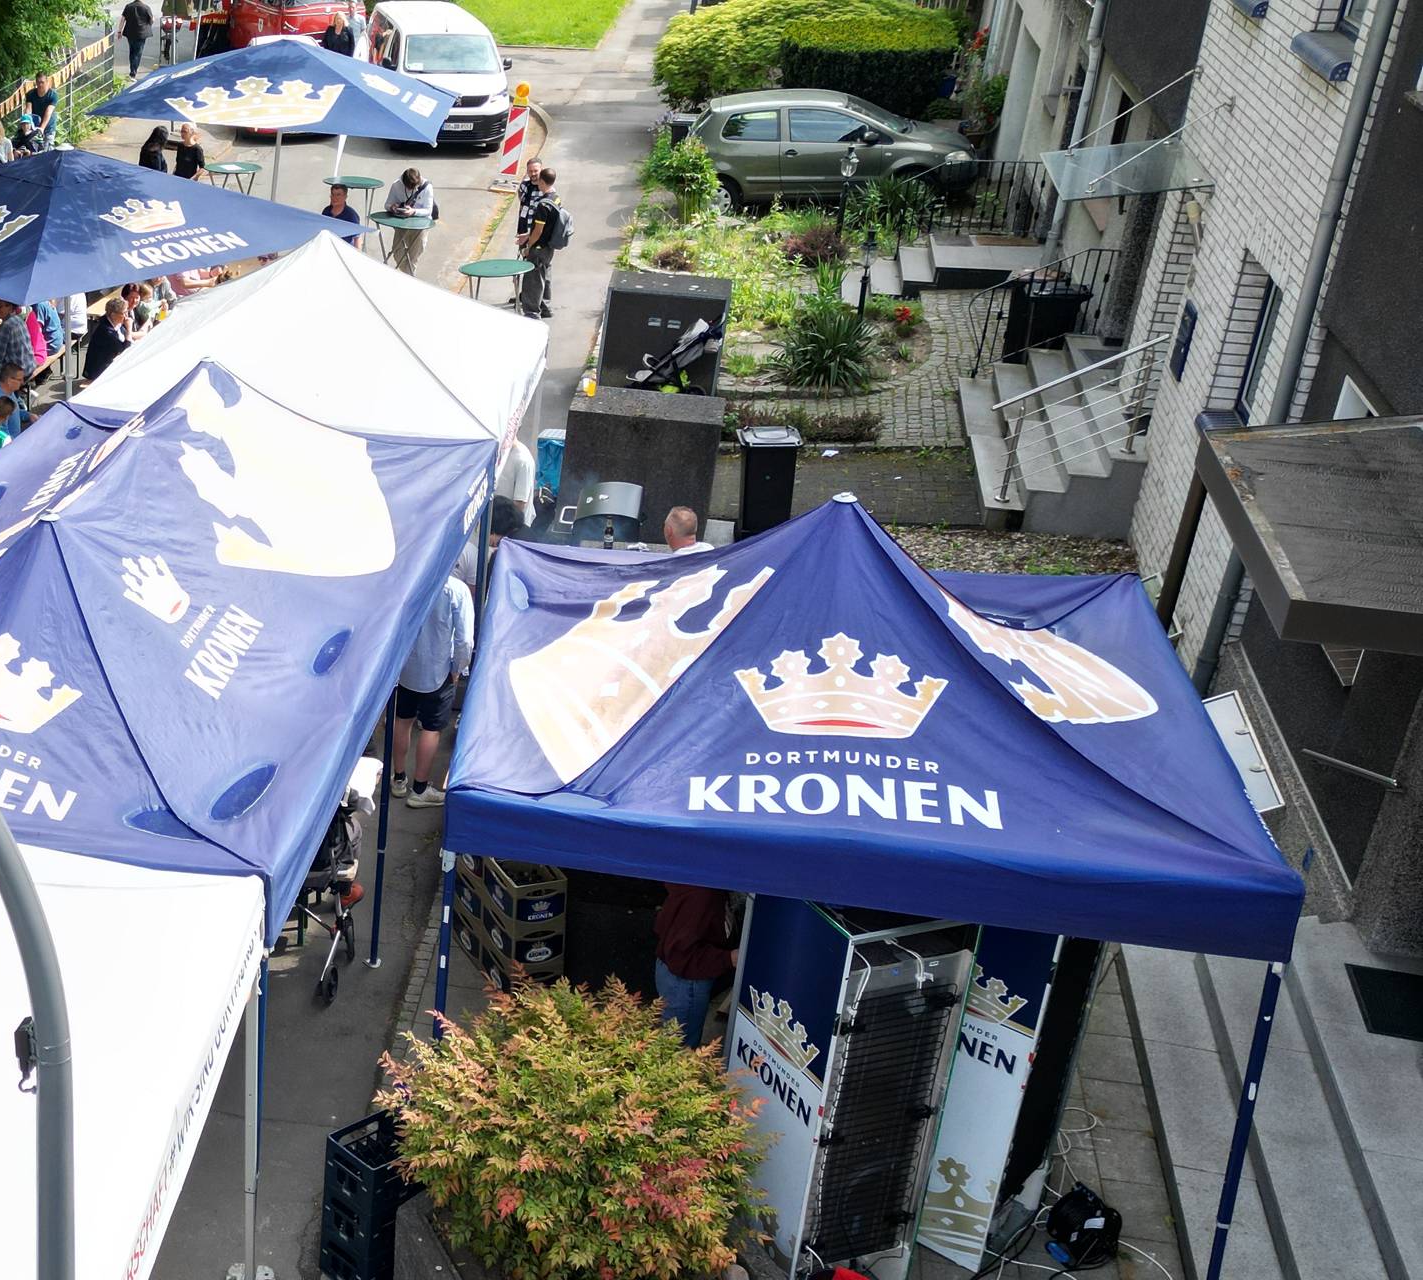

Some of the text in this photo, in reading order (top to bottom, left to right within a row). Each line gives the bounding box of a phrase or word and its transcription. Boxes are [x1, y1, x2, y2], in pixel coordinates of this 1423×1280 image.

[120, 231, 249, 269] KRONEN
[131, 226, 209, 247] DORTMUNDER
[184, 603, 264, 700] KRONEN
[745, 750, 940, 774] DORTMUNDER
[688, 773, 1004, 830] KRONEN
[527, 911, 554, 921] KRONEN
